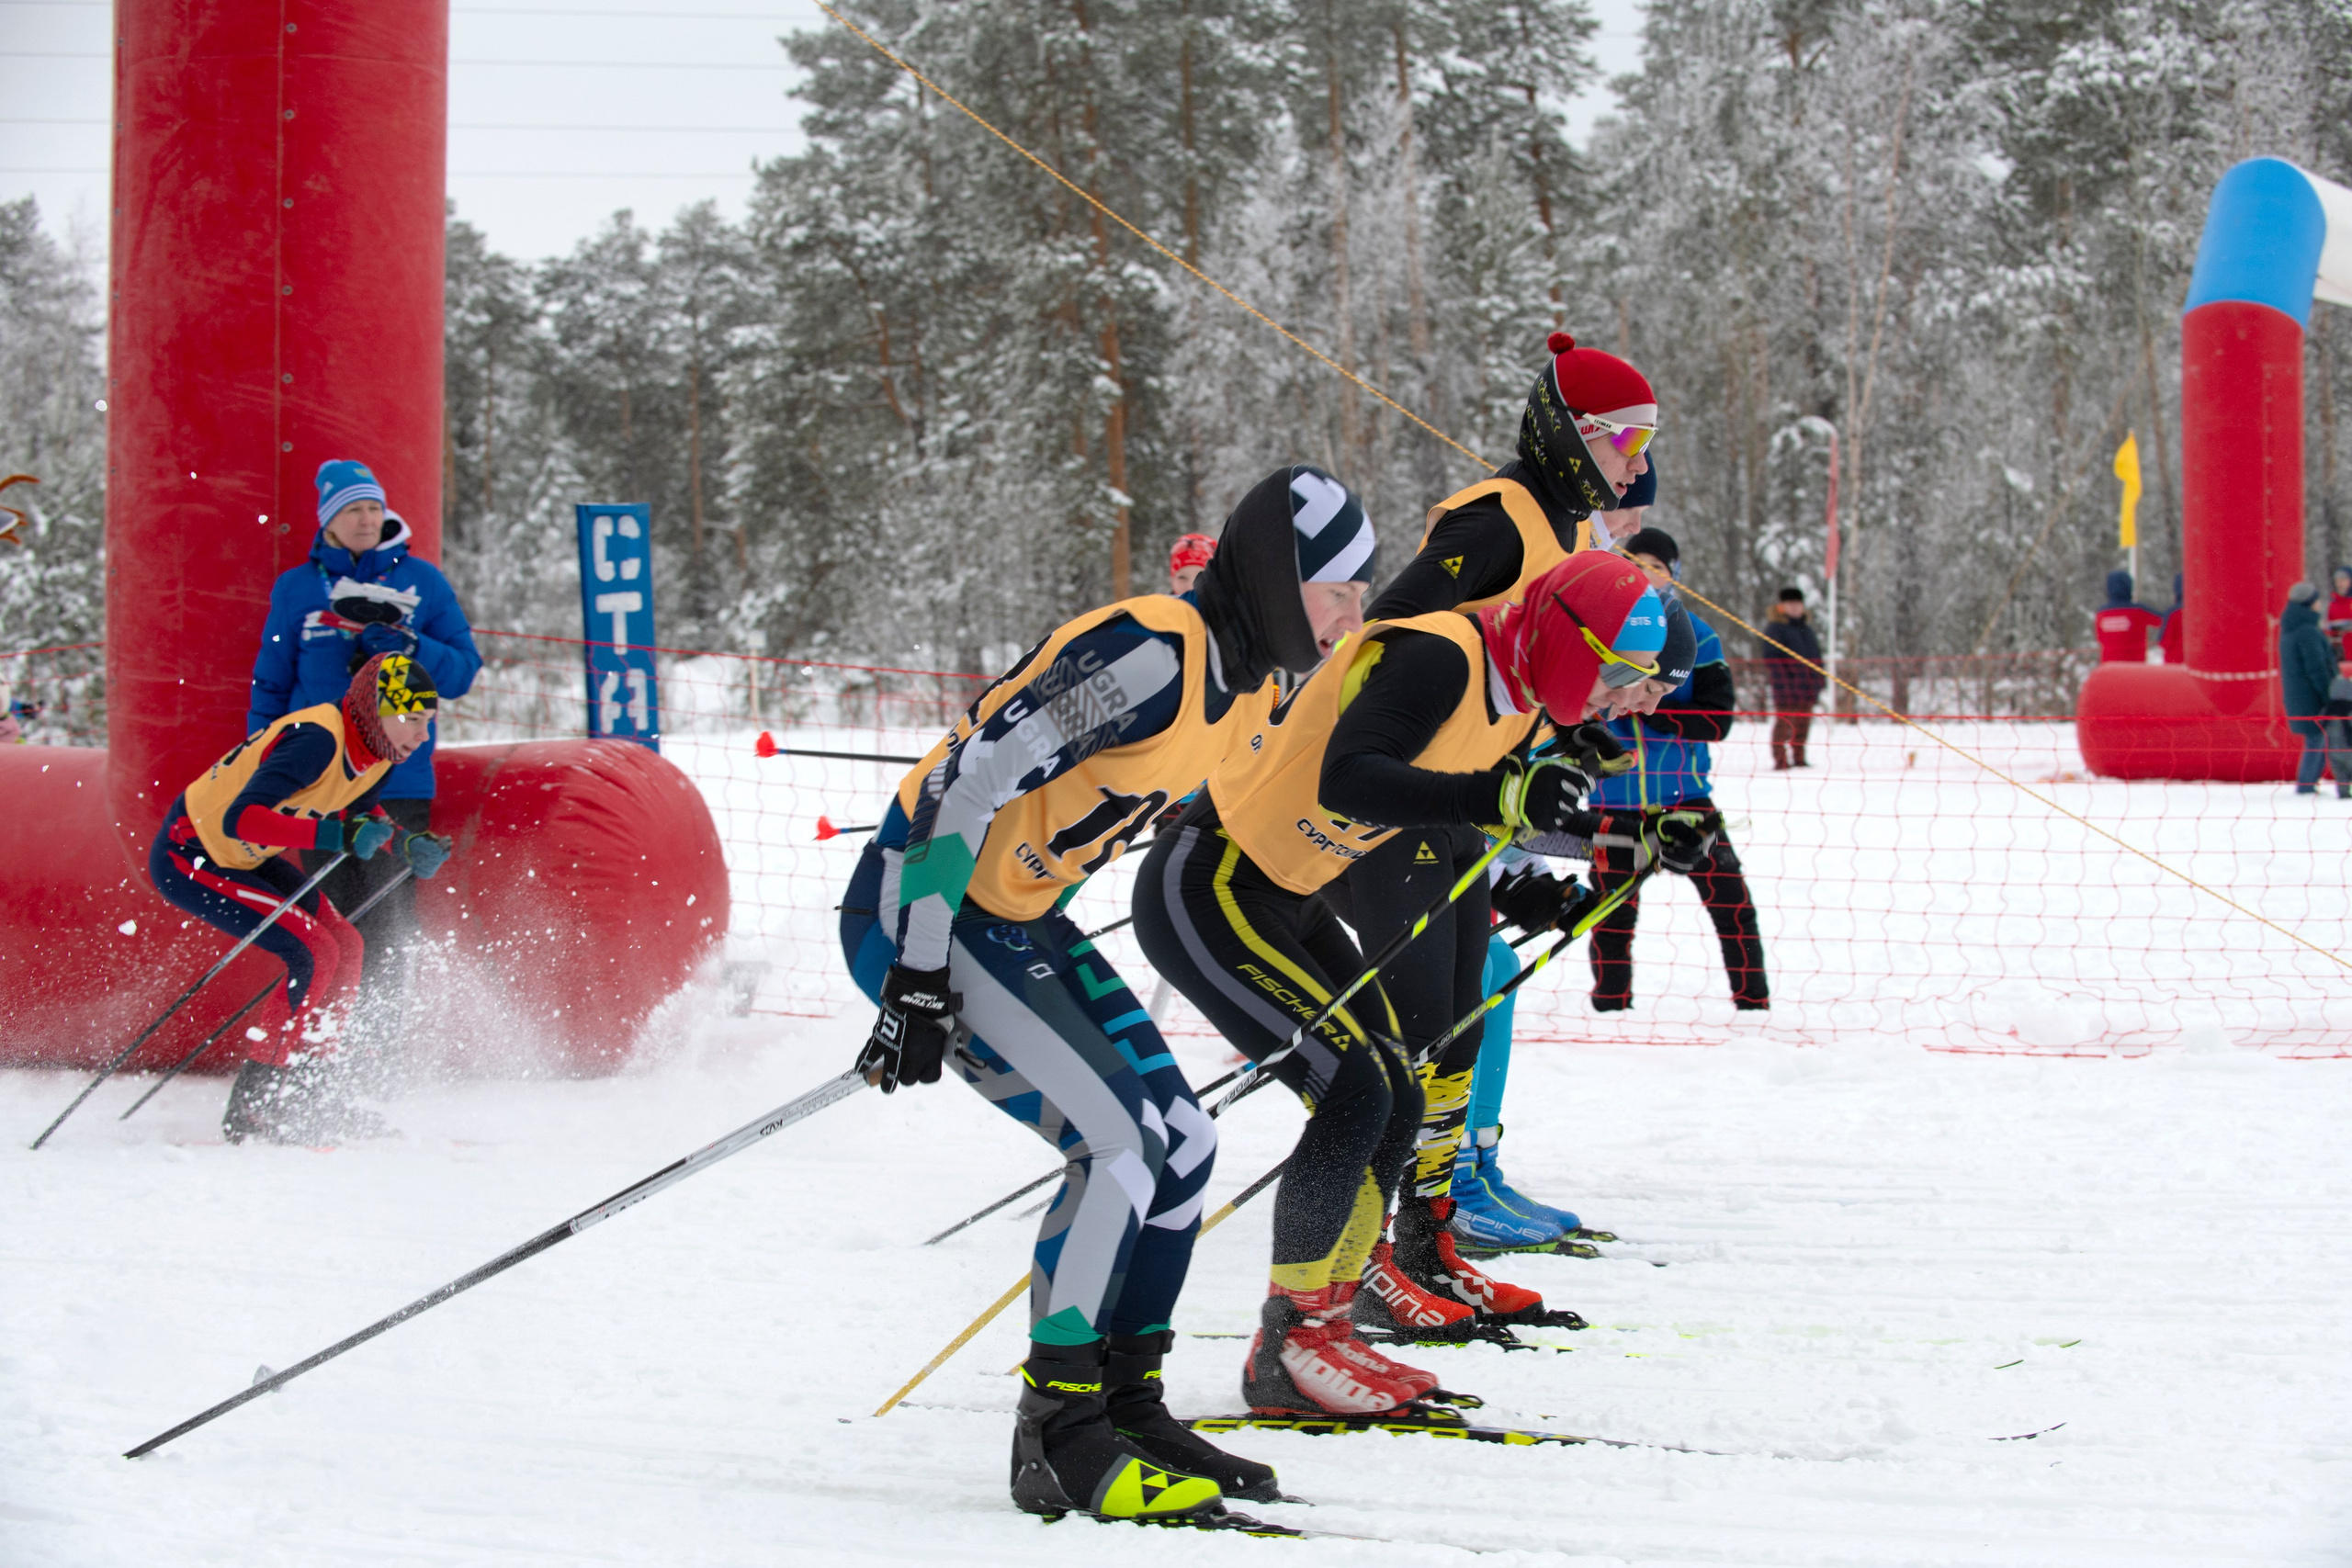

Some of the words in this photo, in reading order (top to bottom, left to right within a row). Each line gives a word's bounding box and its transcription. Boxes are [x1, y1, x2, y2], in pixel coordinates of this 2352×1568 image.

[1077, 649, 1139, 734] UGRA
[1003, 699, 1061, 779] UGRA
[1237, 964, 1338, 1036] FISCHER
[1219, 1068, 1258, 1108] SPORT
[1361, 1258, 1447, 1327] lpina
